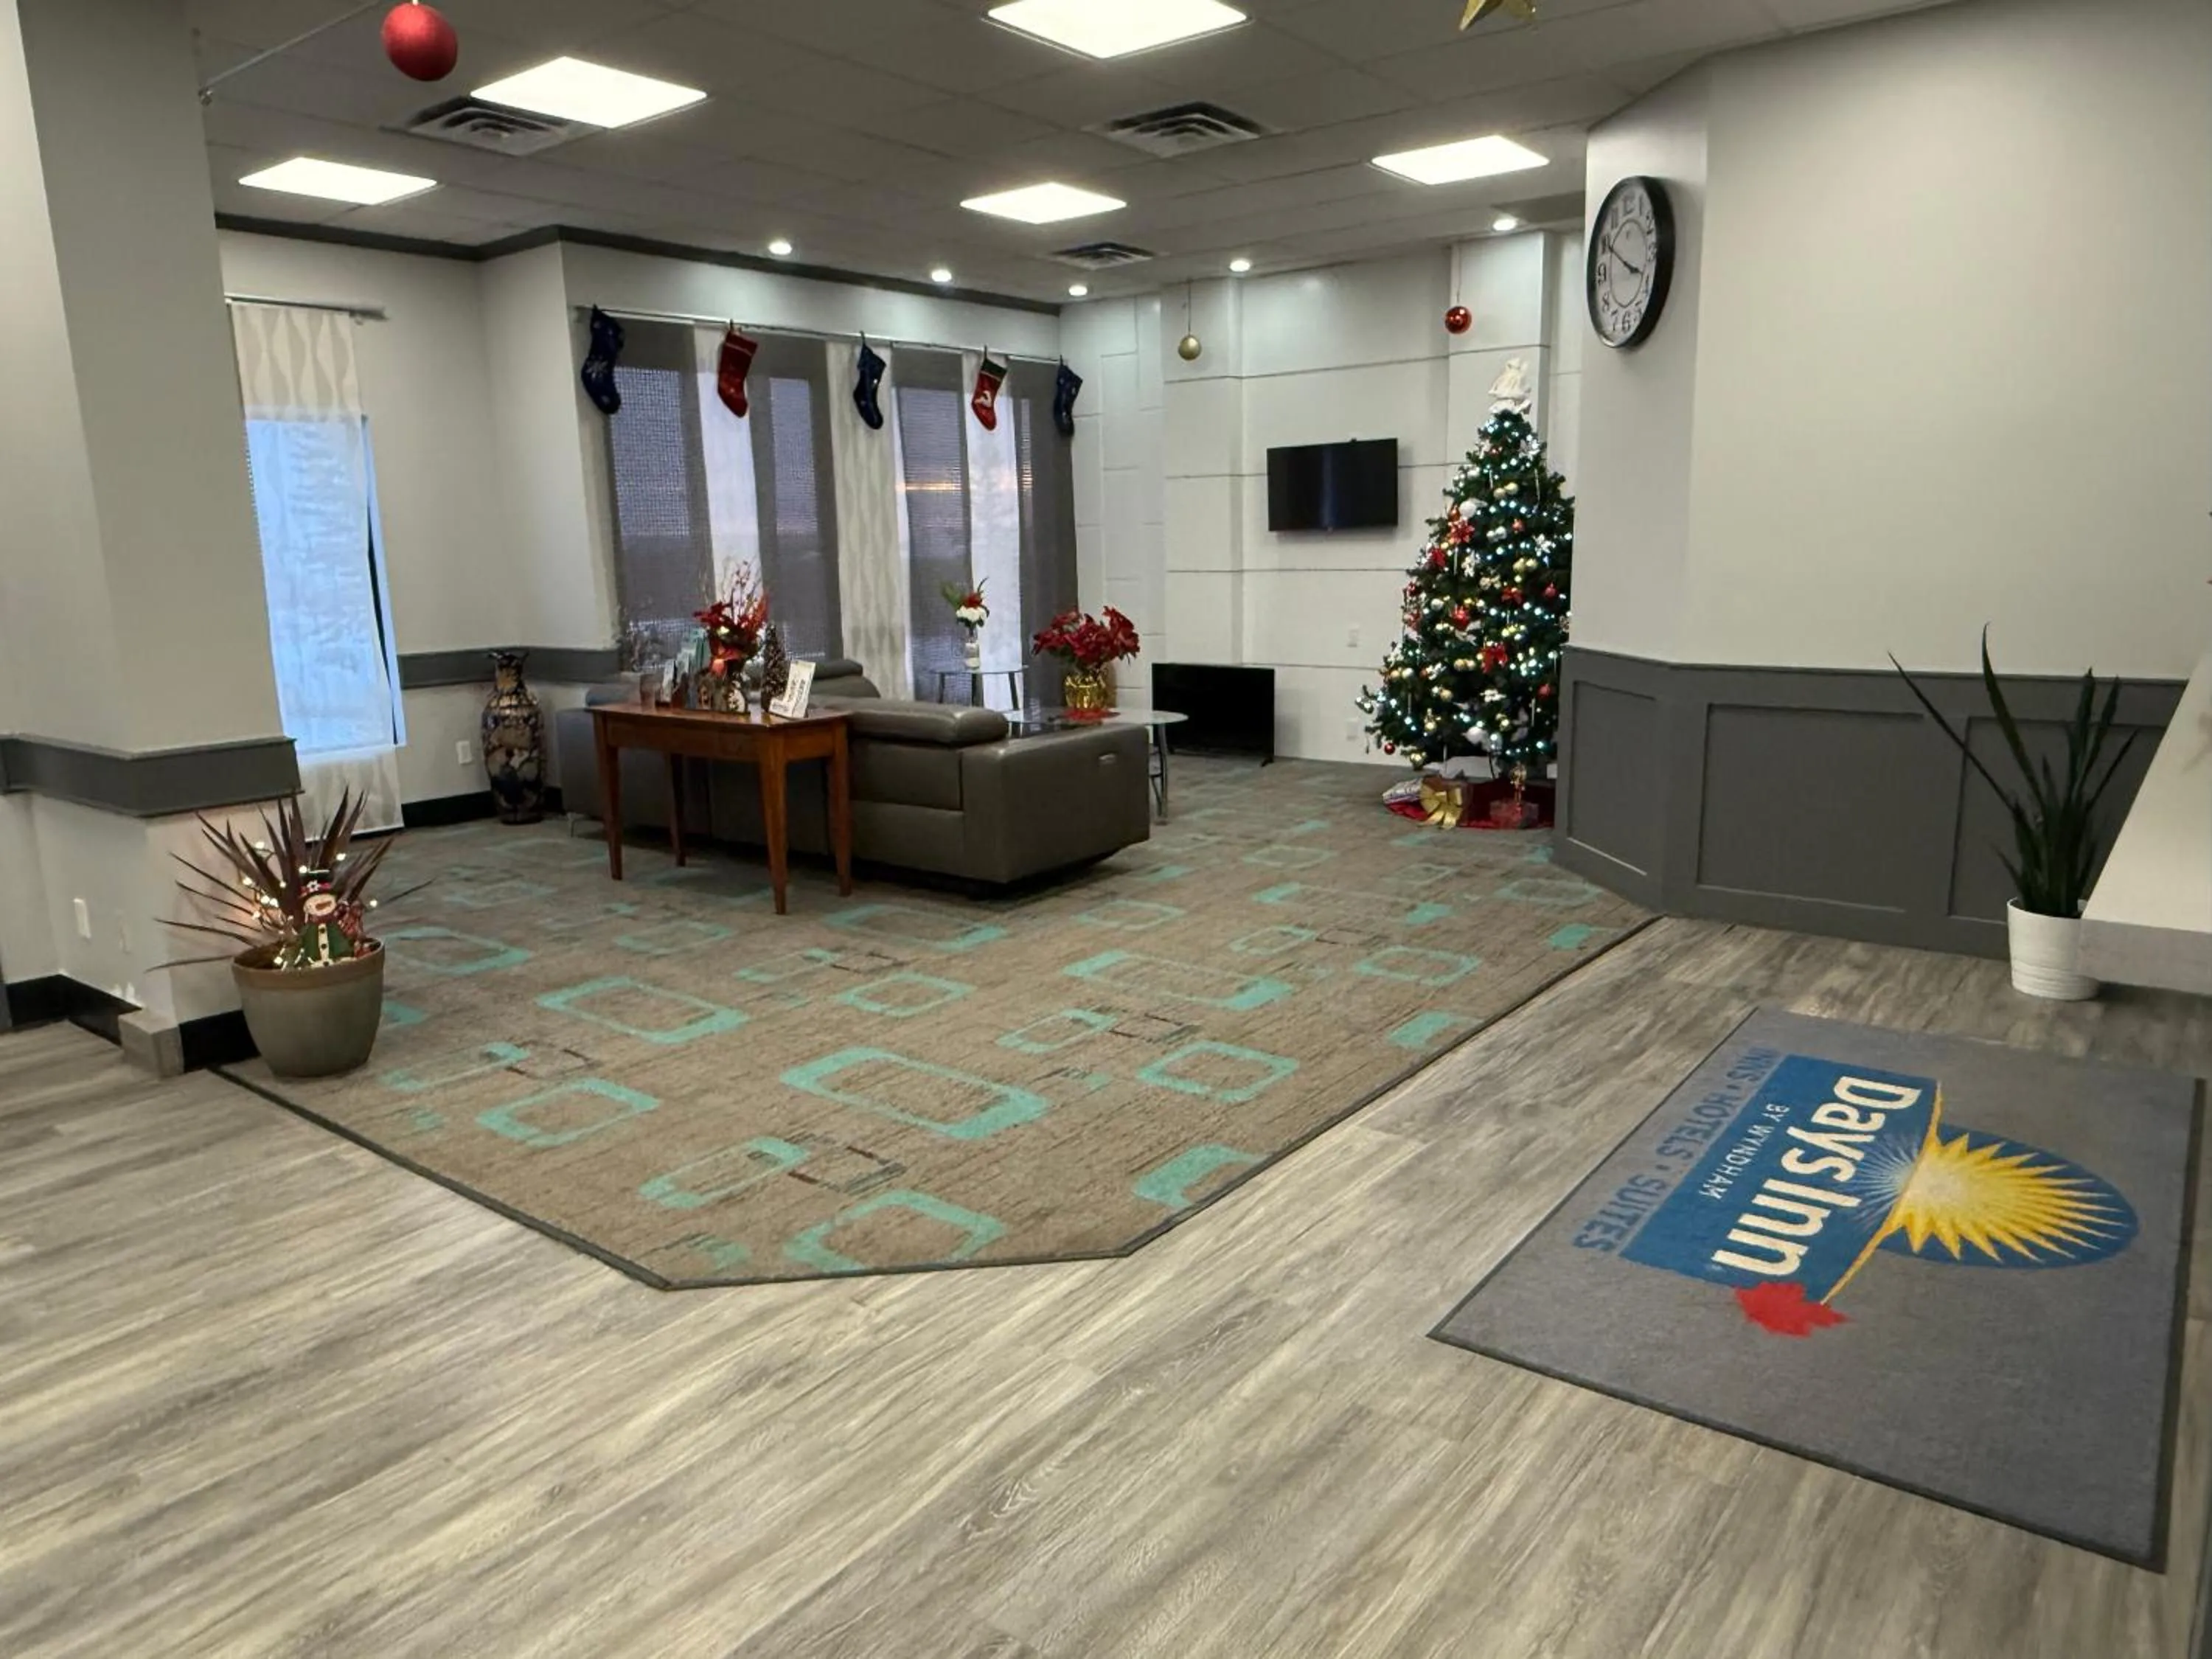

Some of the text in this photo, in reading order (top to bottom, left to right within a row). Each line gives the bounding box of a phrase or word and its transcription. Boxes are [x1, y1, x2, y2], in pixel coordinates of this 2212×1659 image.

[1597, 264, 1606, 285] 9
[1601, 294, 1610, 313] 8
[1610, 310, 1618, 331] 7
[1621, 311, 1630, 333] 6
[1656, 1090, 1741, 1162] HOTELS
[1698, 1103, 1790, 1200] BY WYNDHAM
[1711, 1076, 1921, 1276] Days Inn
[1572, 1174, 1664, 1252] SUITES
